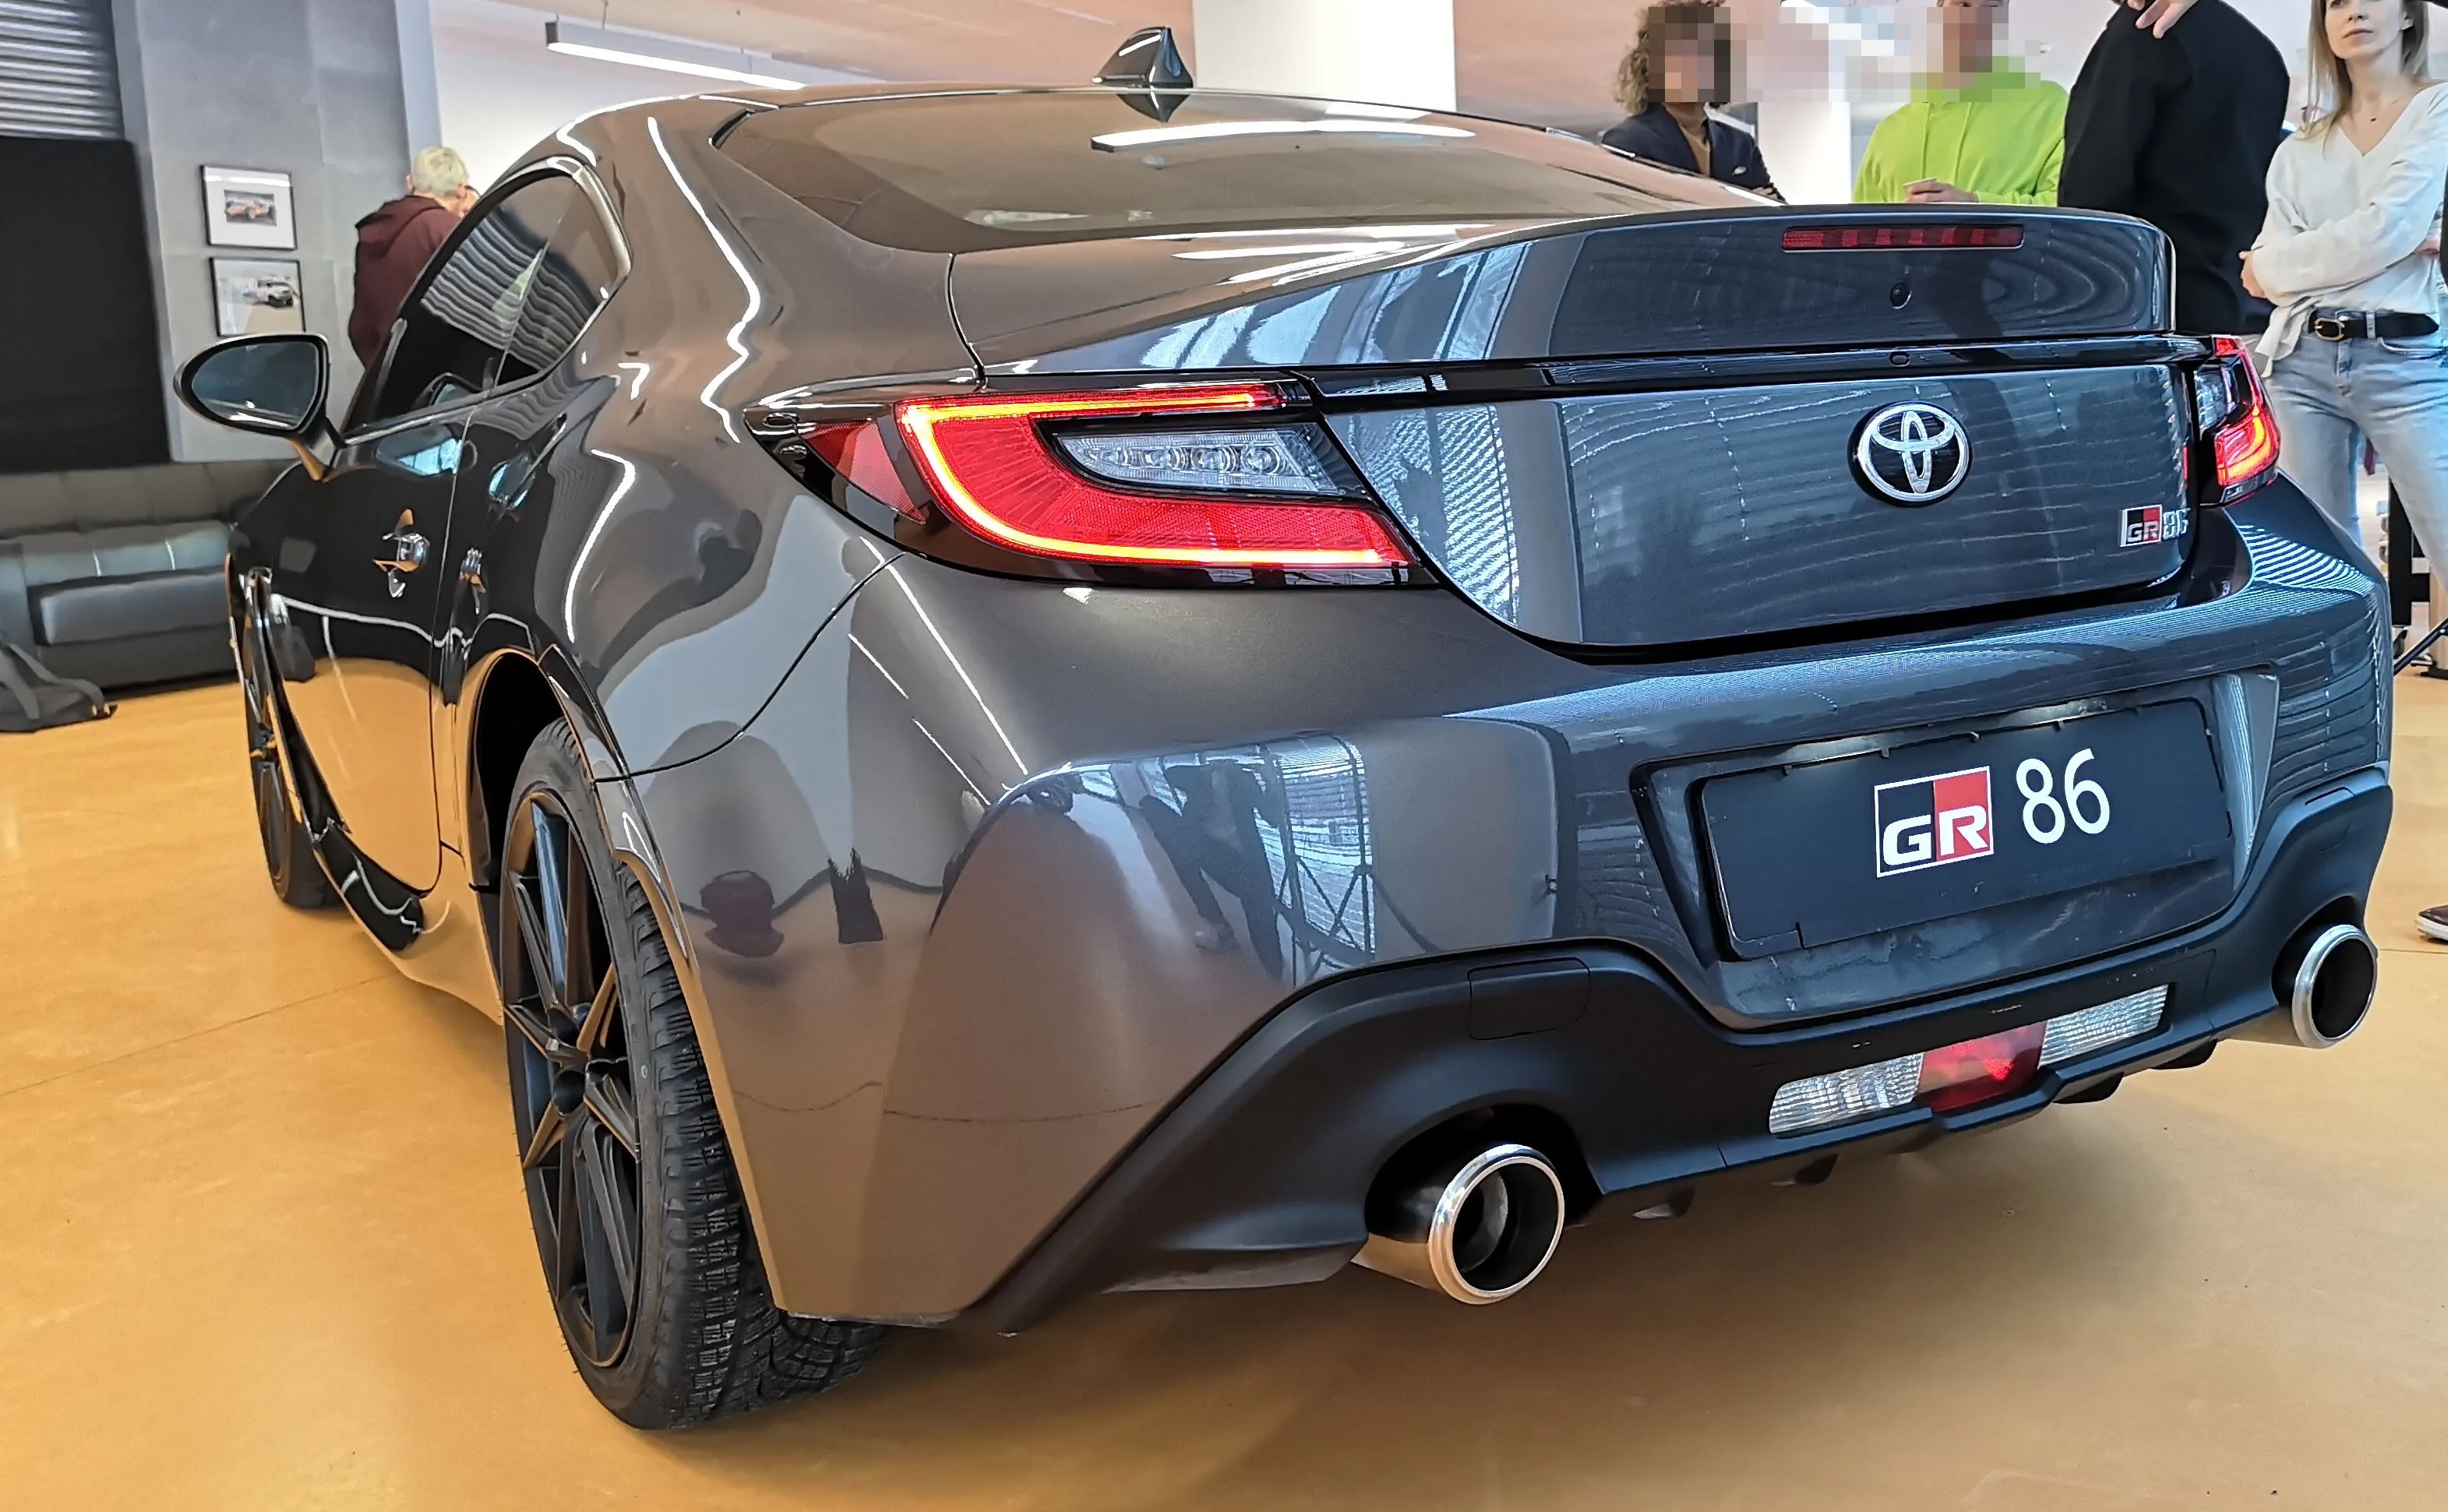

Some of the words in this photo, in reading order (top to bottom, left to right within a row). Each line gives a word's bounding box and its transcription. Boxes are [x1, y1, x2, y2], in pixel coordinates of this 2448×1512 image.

[2127, 520, 2158, 542] GR
[1882, 805, 1988, 865] GR
[2016, 748, 2110, 844] 86
